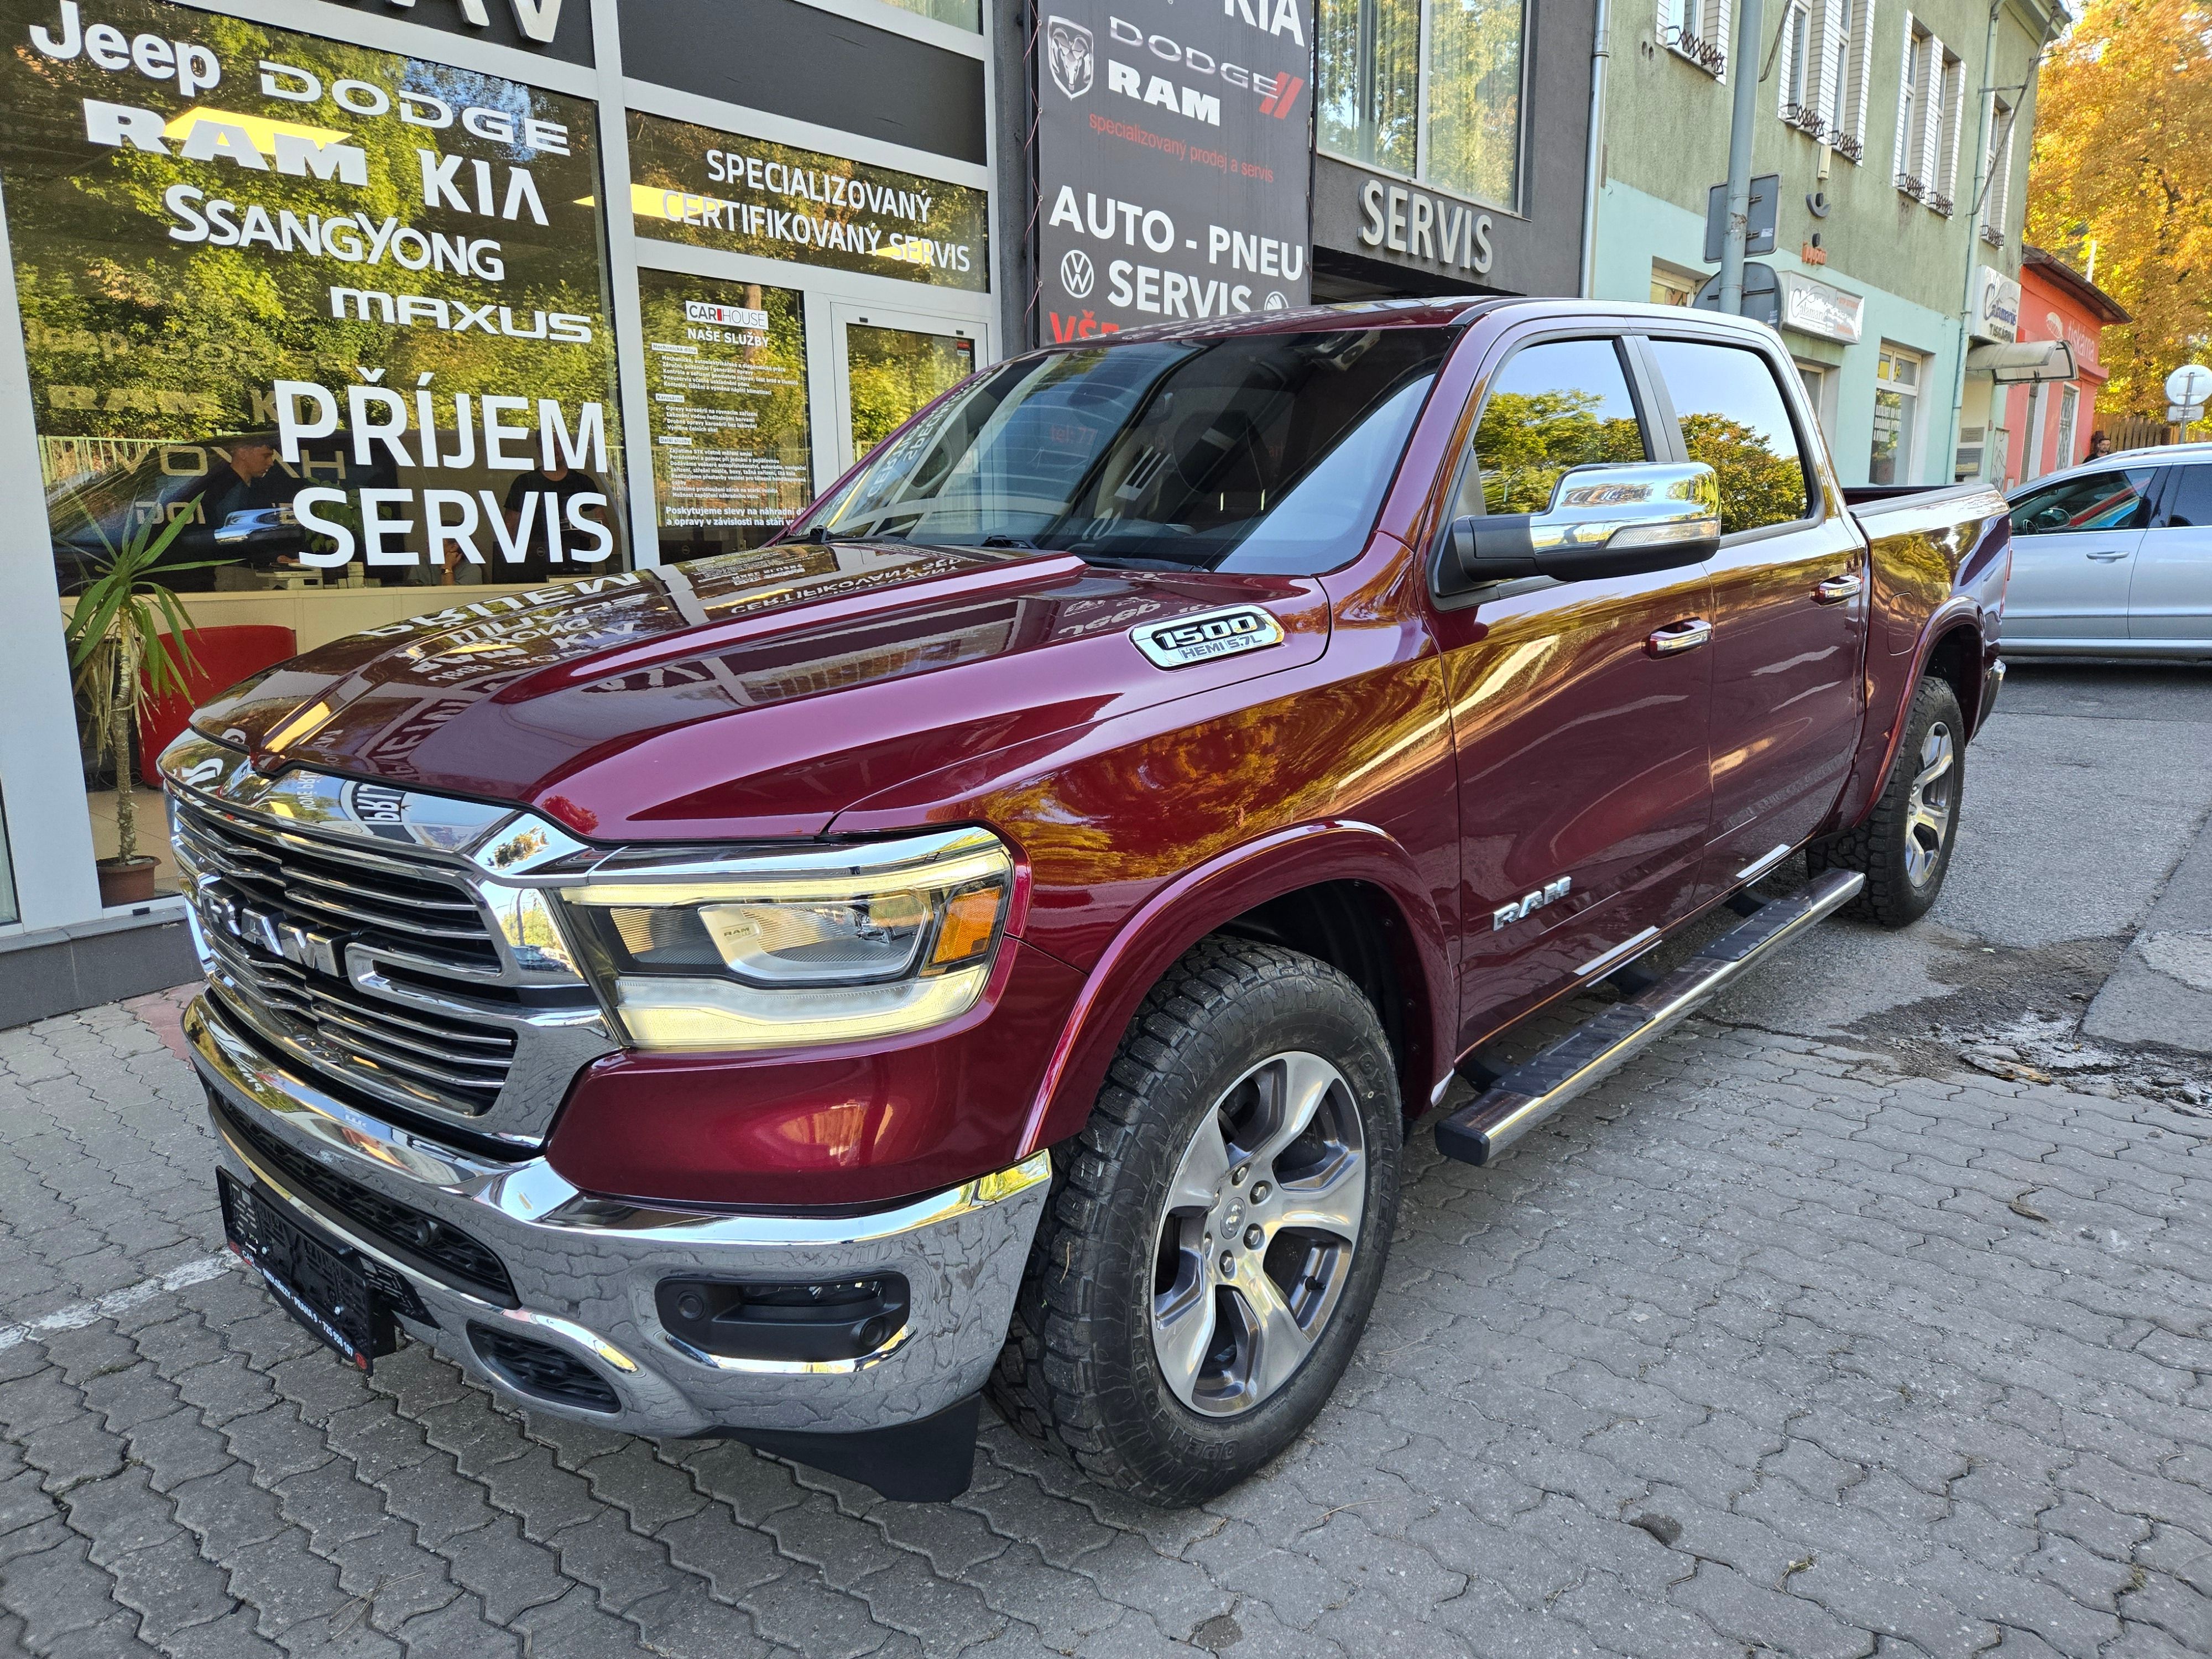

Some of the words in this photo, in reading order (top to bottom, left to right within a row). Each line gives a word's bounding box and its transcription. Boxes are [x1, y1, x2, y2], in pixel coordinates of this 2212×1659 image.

[29, 0, 221, 97] Jeep
[258, 59, 571, 156] DODGE
[1108, 59, 1220, 126] RAM
[1110, 16, 1278, 100] DODGE
[83, 98, 368, 187] RAM
[417, 148, 550, 226] KIA
[1089, 112, 1186, 161] specializovaný
[1191, 145, 1228, 174] prodej
[1230, 158, 1238, 172] a
[1241, 161, 1274, 183] servis
[707, 149, 932, 223] SPECIALIZOVANÝ
[164, 184, 504, 281] SSANGYONG
[664, 191, 881, 255] CERTIFIKOVANÝ
[889, 232, 971, 272] SERVIS
[1048, 185, 1175, 253] AUTO
[1209, 225, 1303, 281] PNEU
[1358, 179, 1493, 274] SERVIS
[331, 286, 592, 343] MAXUS
[1108, 260, 1252, 319] SERVIS
[687, 327, 720, 342] NAŠE
[724, 332, 769, 347] SLUŽBY
[2068, 321, 2095, 362] tiskárna
[274, 367, 607, 473] PŘÍJEM
[293, 487, 613, 568] SERVIS
[666, 507, 723, 516] Poskytujeme
[724, 507, 744, 516] slevy
[675, 518, 703, 526] opravy
[1155, 615, 1258, 649] 1500
[1181, 642, 1225, 659] HEMI
[1226, 635, 1262, 649] 5.7L
[198, 873, 353, 978] RAM
[724, 927, 750, 936] RAM
[1493, 876, 1572, 931] RAM
